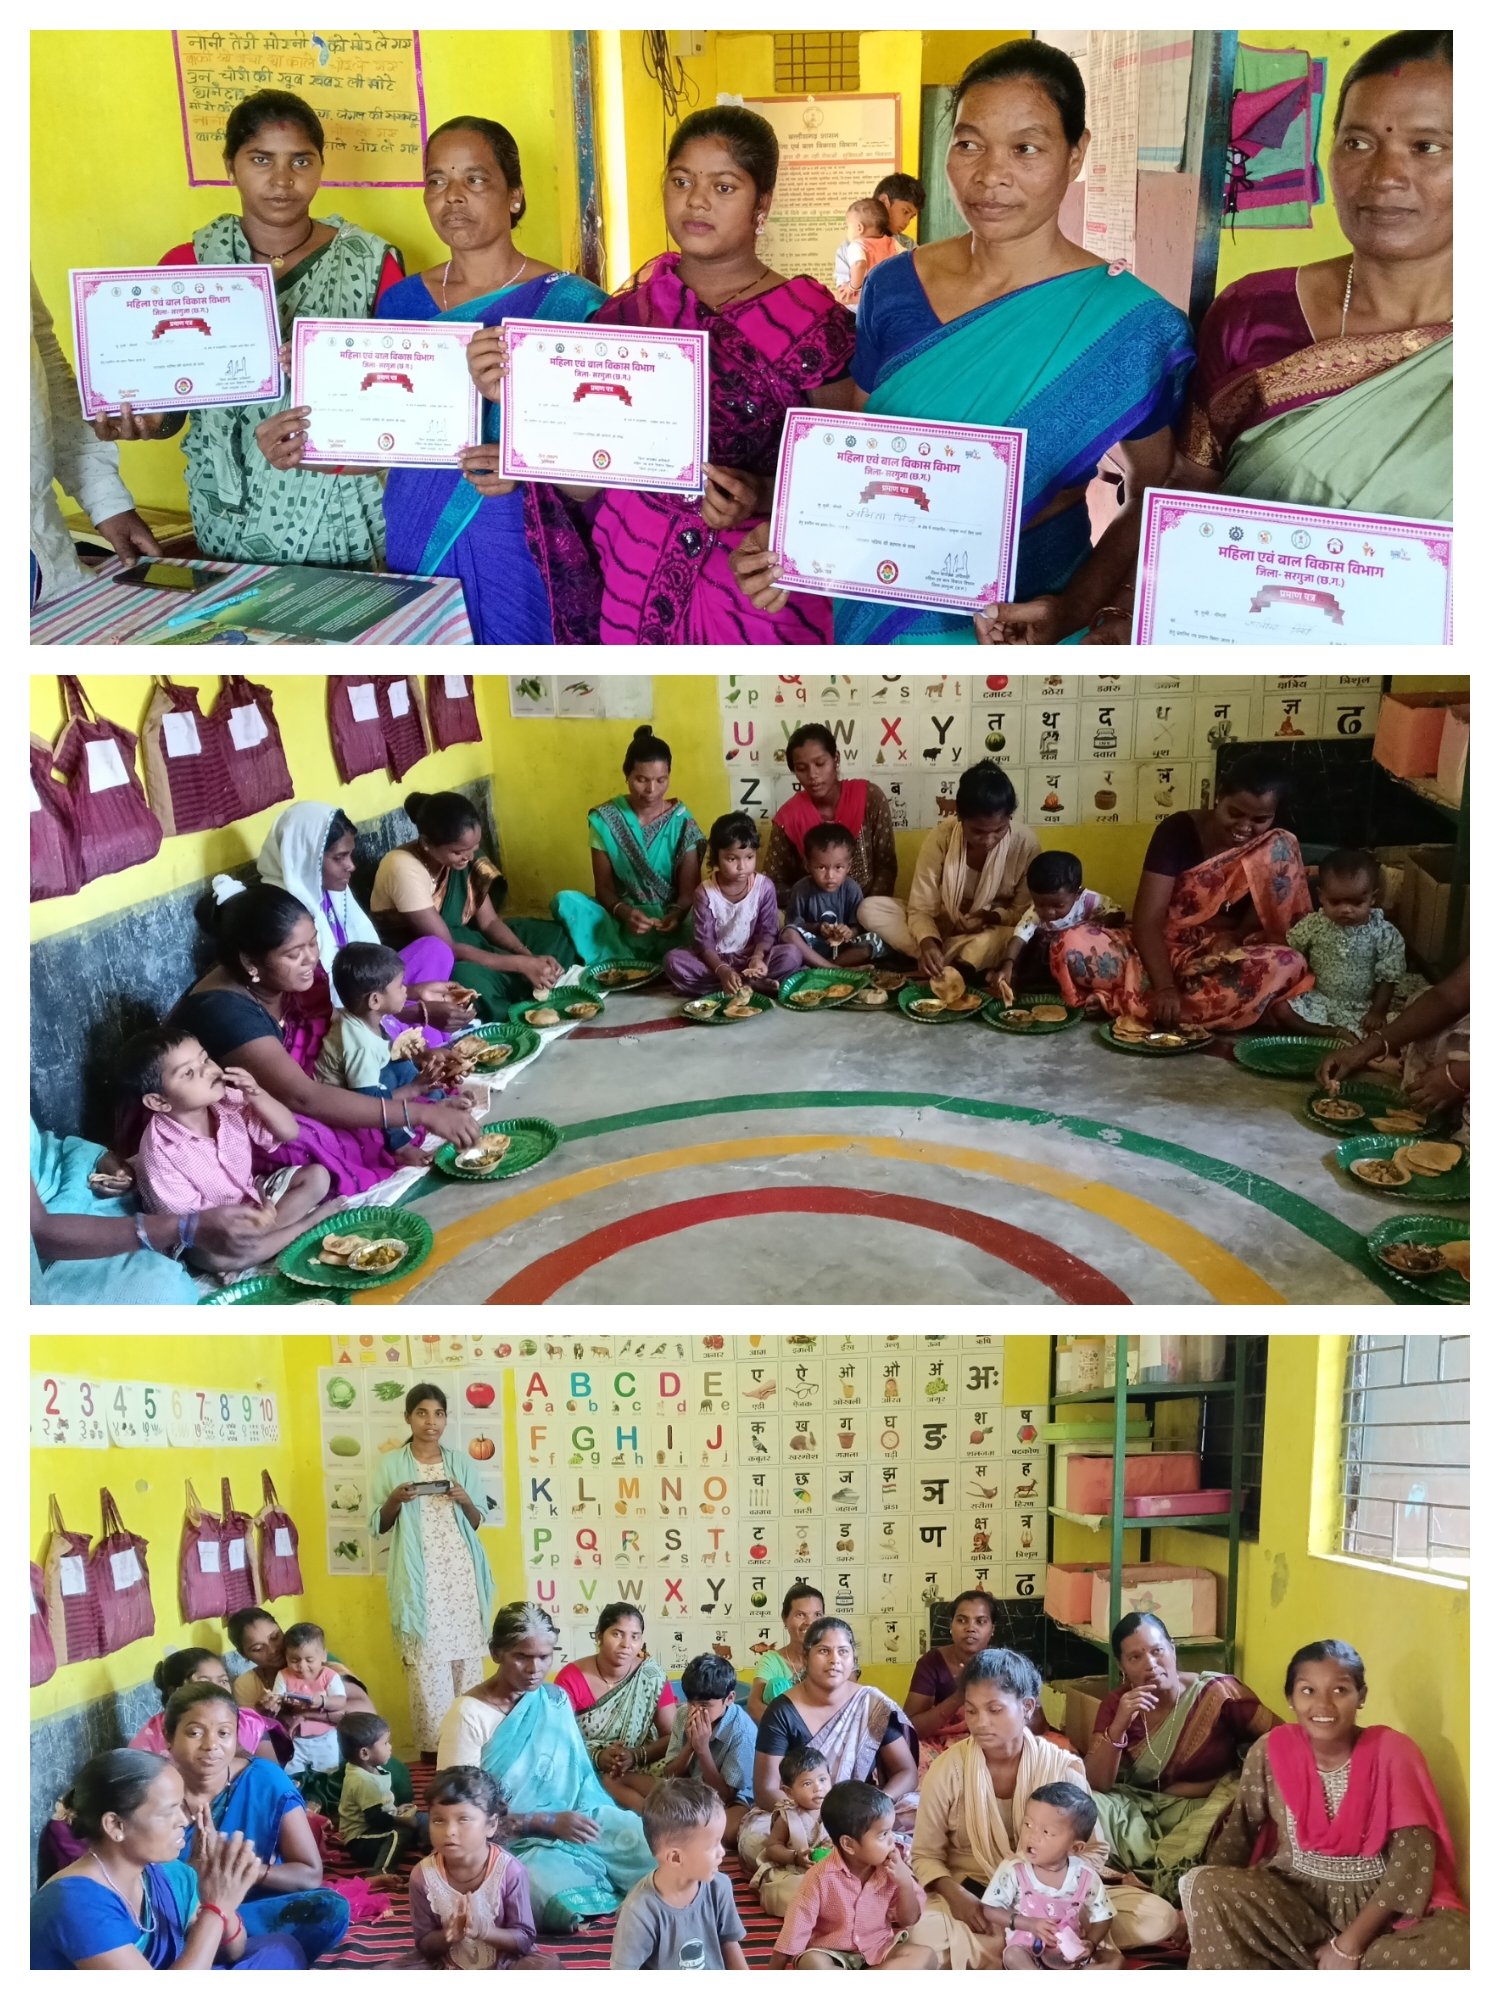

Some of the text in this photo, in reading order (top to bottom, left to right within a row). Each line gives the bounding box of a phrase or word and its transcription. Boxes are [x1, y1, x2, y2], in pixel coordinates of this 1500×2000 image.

[186, 31, 225, 50] नानी
[229, 32, 259, 50] तेरी
[264, 30, 310, 50] मोरनी
[126, 298, 150, 308] महिला
[183, 296, 207, 305] विकास
[550, 356, 573, 368] महिला
[605, 359, 630, 371] विकास
[632, 361, 655, 373] विभाग
[837, 450, 961, 473] महिला एवं बाल विकास विभाग
[1218, 545, 1385, 578] महिला एवं बाल विकास विभाग
[1284, 571, 1314, 585] सरगुजा
[1316, 575, 1345, 588] (छ.ग.)
[1280, 590, 1316, 602] प्रमाण पत्र
[1099, 707, 1115, 726] द
[1214, 704, 1231, 719] न
[1282, 699, 1301, 715] ज्ञ
[931, 715, 954, 745] Y
[988, 713, 1005, 731] त
[1042, 712, 1060, 729] थ
[734, 721, 754, 746] U
[880, 717, 902, 746] X
[740, 778, 762, 805] Z
[1046, 775, 1061, 789] य
[751, 1368, 764, 1383] ए
[796, 1364, 808, 1381] ऐ
[838, 1363, 855, 1378] ओ
[883, 1361, 900, 1378] औ
[929, 1360, 944, 1376] अं
[966, 1366, 1000, 1391] अः
[526, 1372, 548, 1397] A
[570, 1372, 592, 1397] B
[614, 1372, 636, 1398] C
[659, 1372, 681, 1397] D
[703, 1372, 723, 1397] E
[44, 1379, 60, 1415] 2
[80, 1382, 94, 1417] 3
[113, 1385, 127, 1418] 4
[145, 1388, 156, 1419] 5
[196, 1392, 205, 1421] 7
[220, 1394, 230, 1421] 8
[242, 1395, 252, 1422] 9
[260, 1398, 273, 1422] 10
[974, 1412, 988, 1425] श
[1021, 1410, 1033, 1423] ष
[751, 1421, 766, 1435] क
[795, 1420, 810, 1433] ख
[840, 1417, 853, 1430] ग
[884, 1415, 898, 1429] घ
[530, 1426, 547, 1450] F
[571, 1426, 595, 1451] G
[617, 1426, 637, 1450] H
[667, 1425, 673, 1450] I
[706, 1424, 722, 1450] J
[923, 1423, 947, 1451] ङ
[752, 1474, 765, 1486] च
[795, 1472, 810, 1486] छ
[839, 1470, 854, 1484] ज
[882, 1467, 898, 1482] झ
[975, 1465, 988, 1477] स
[1022, 1463, 1032, 1476] ह
[531, 1477, 553, 1502] K
[579, 1477, 596, 1501] L
[618, 1477, 640, 1499] M
[661, 1477, 682, 1501] N
[703, 1476, 727, 1501] O
[921, 1479, 949, 1505] ञ
[840, 1523, 852, 1538] ड
[883, 1522, 895, 1536] ढ
[974, 1517, 989, 1530] क्ष
[1021, 1514, 1033, 1529] त्र
[534, 1528, 552, 1552] P
[576, 1528, 598, 1552] Q
[622, 1530, 640, 1551] R
[665, 1529, 682, 1551] S
[707, 1528, 725, 1550] T
[753, 1527, 765, 1540] ट
[920, 1526, 946, 1547] ण
[752, 1576, 766, 1591] त
[838, 1574, 851, 1588] द
[925, 1572, 938, 1584] न
[975, 1568, 989, 1580] ज्ञ
[537, 1580, 555, 1601] U
[579, 1579, 597, 1600] V
[617, 1579, 643, 1601] W
[665, 1578, 683, 1602] X
[706, 1578, 726, 1601] Y
